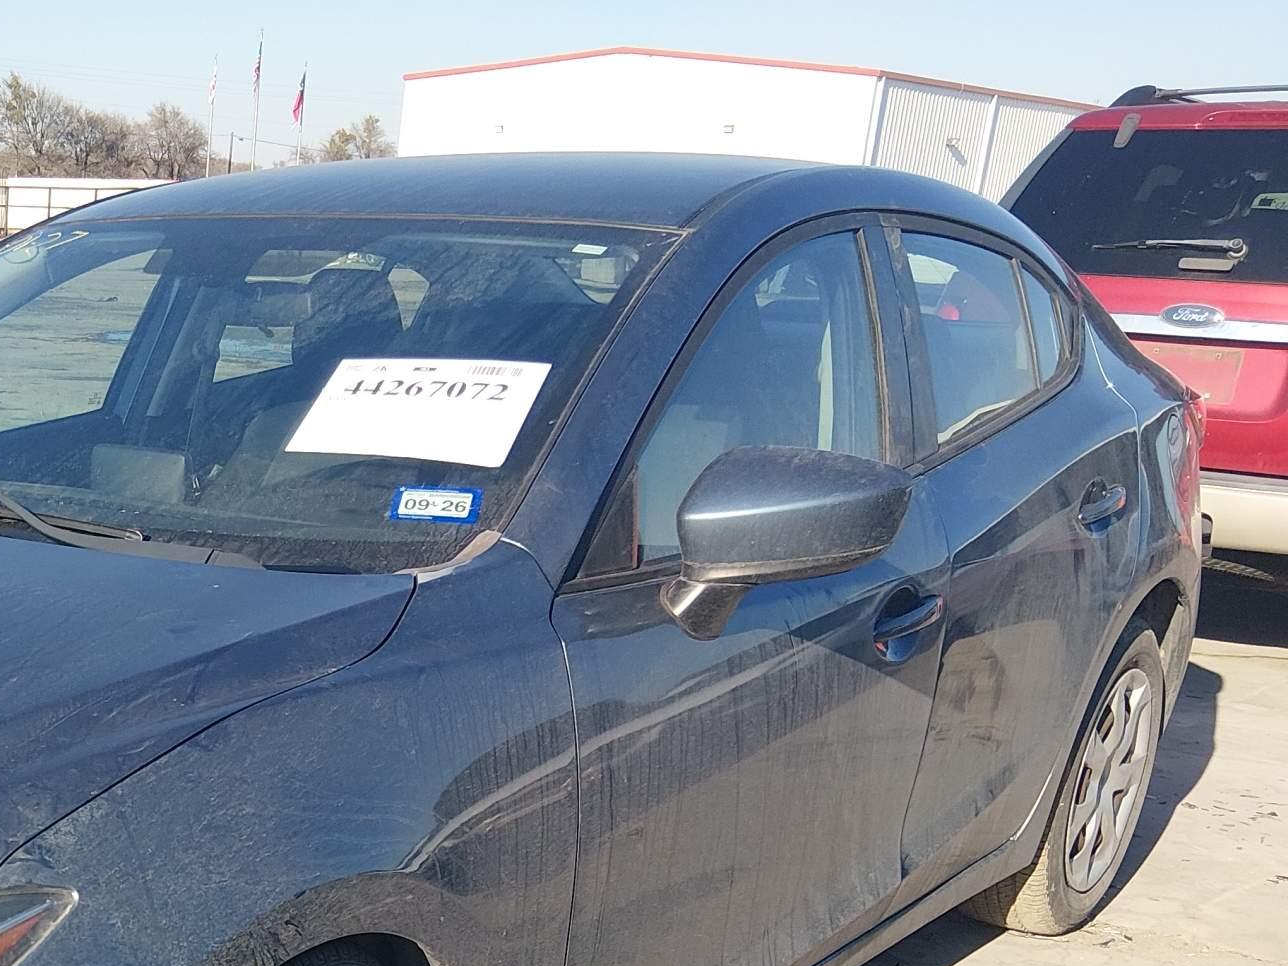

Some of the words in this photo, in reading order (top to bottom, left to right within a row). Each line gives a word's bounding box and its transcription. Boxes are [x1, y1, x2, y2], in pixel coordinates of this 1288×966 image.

[1173, 307, 1208, 321] Ford
[344, 380, 509, 400] 44267072
[404, 499, 431, 511] 09
[440, 500, 467, 512] 26
